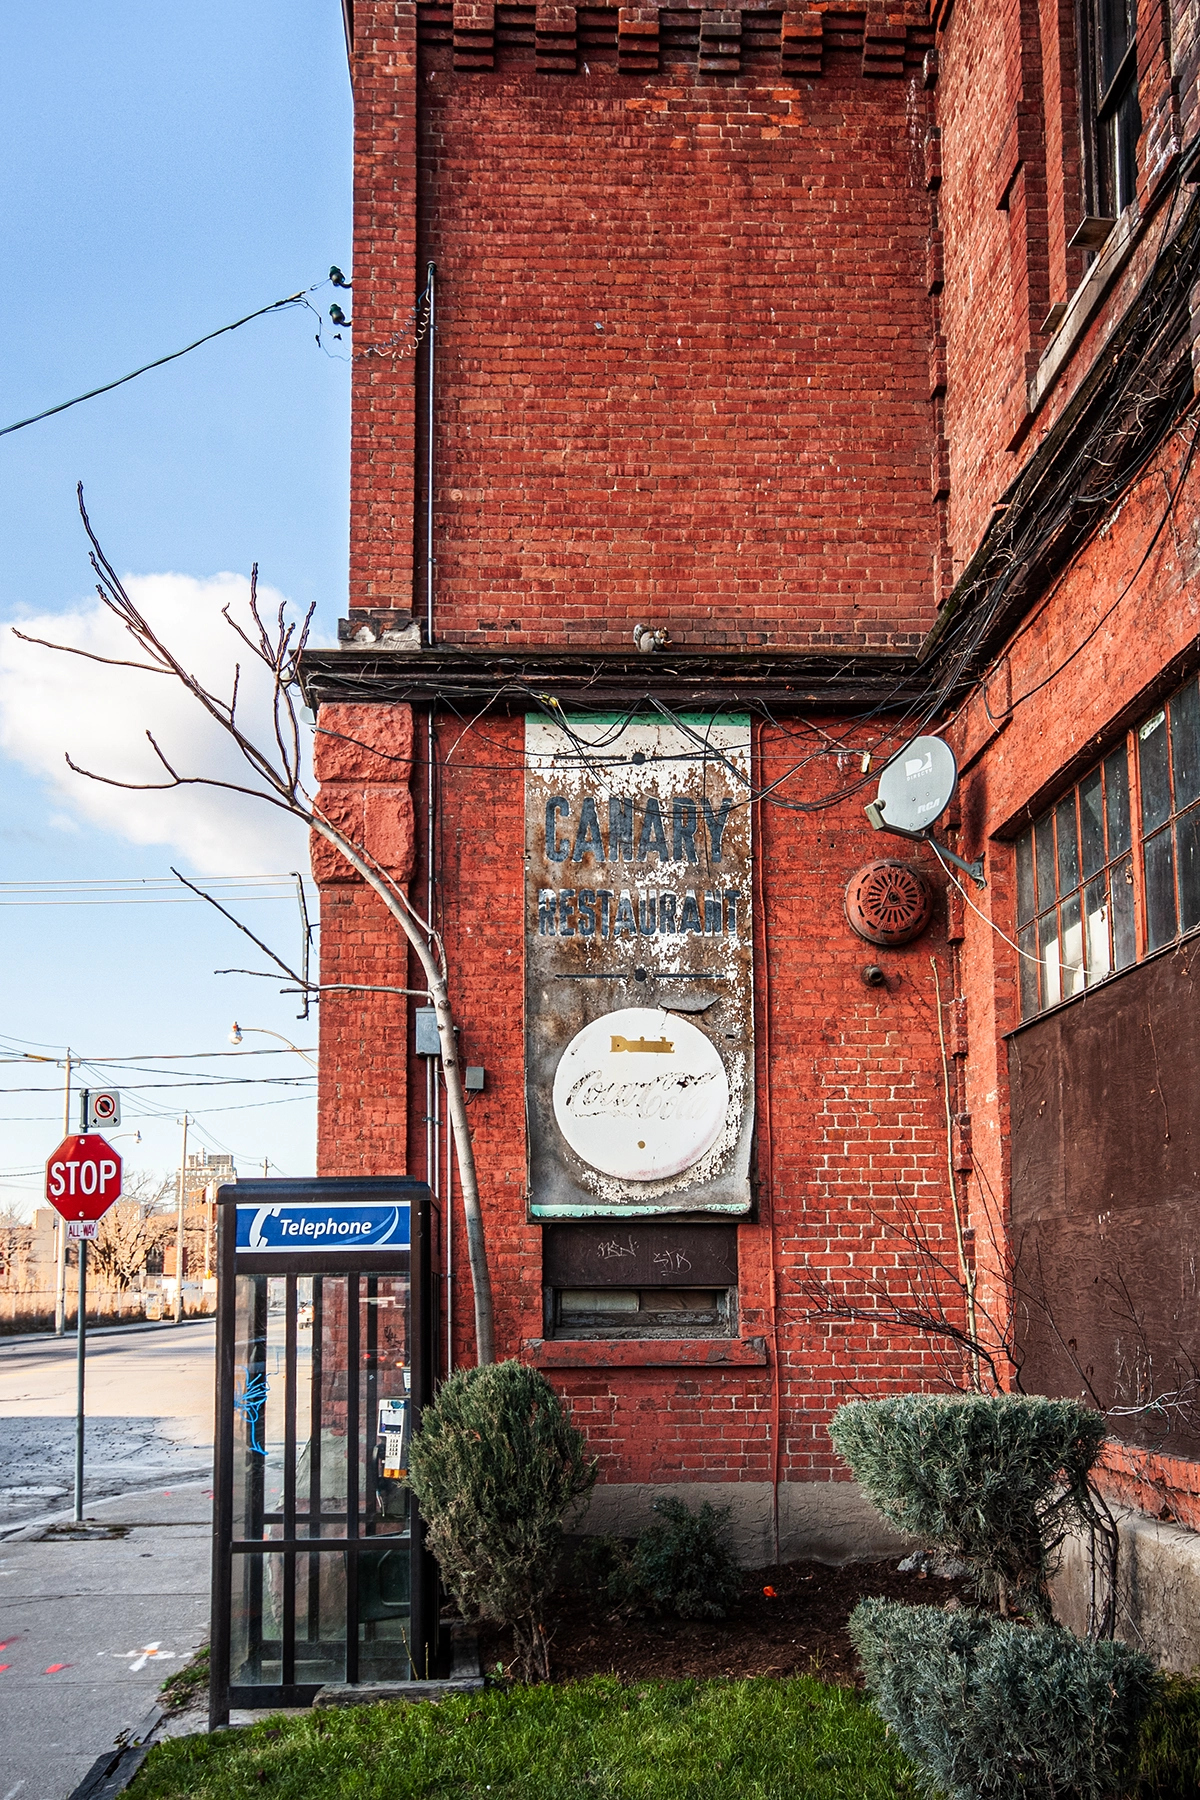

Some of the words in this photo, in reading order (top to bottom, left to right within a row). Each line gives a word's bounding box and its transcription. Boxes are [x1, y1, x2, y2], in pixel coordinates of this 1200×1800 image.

[906, 767, 933, 781] DIRECTV
[917, 798, 940, 814] RCA
[545, 796, 733, 863] CANARY
[538, 888, 740, 937] RESTAURANT
[49, 1160, 117, 1196] STOP
[68, 1223, 97, 1237] ALL-WAY
[280, 1218, 372, 1239] Telephone
